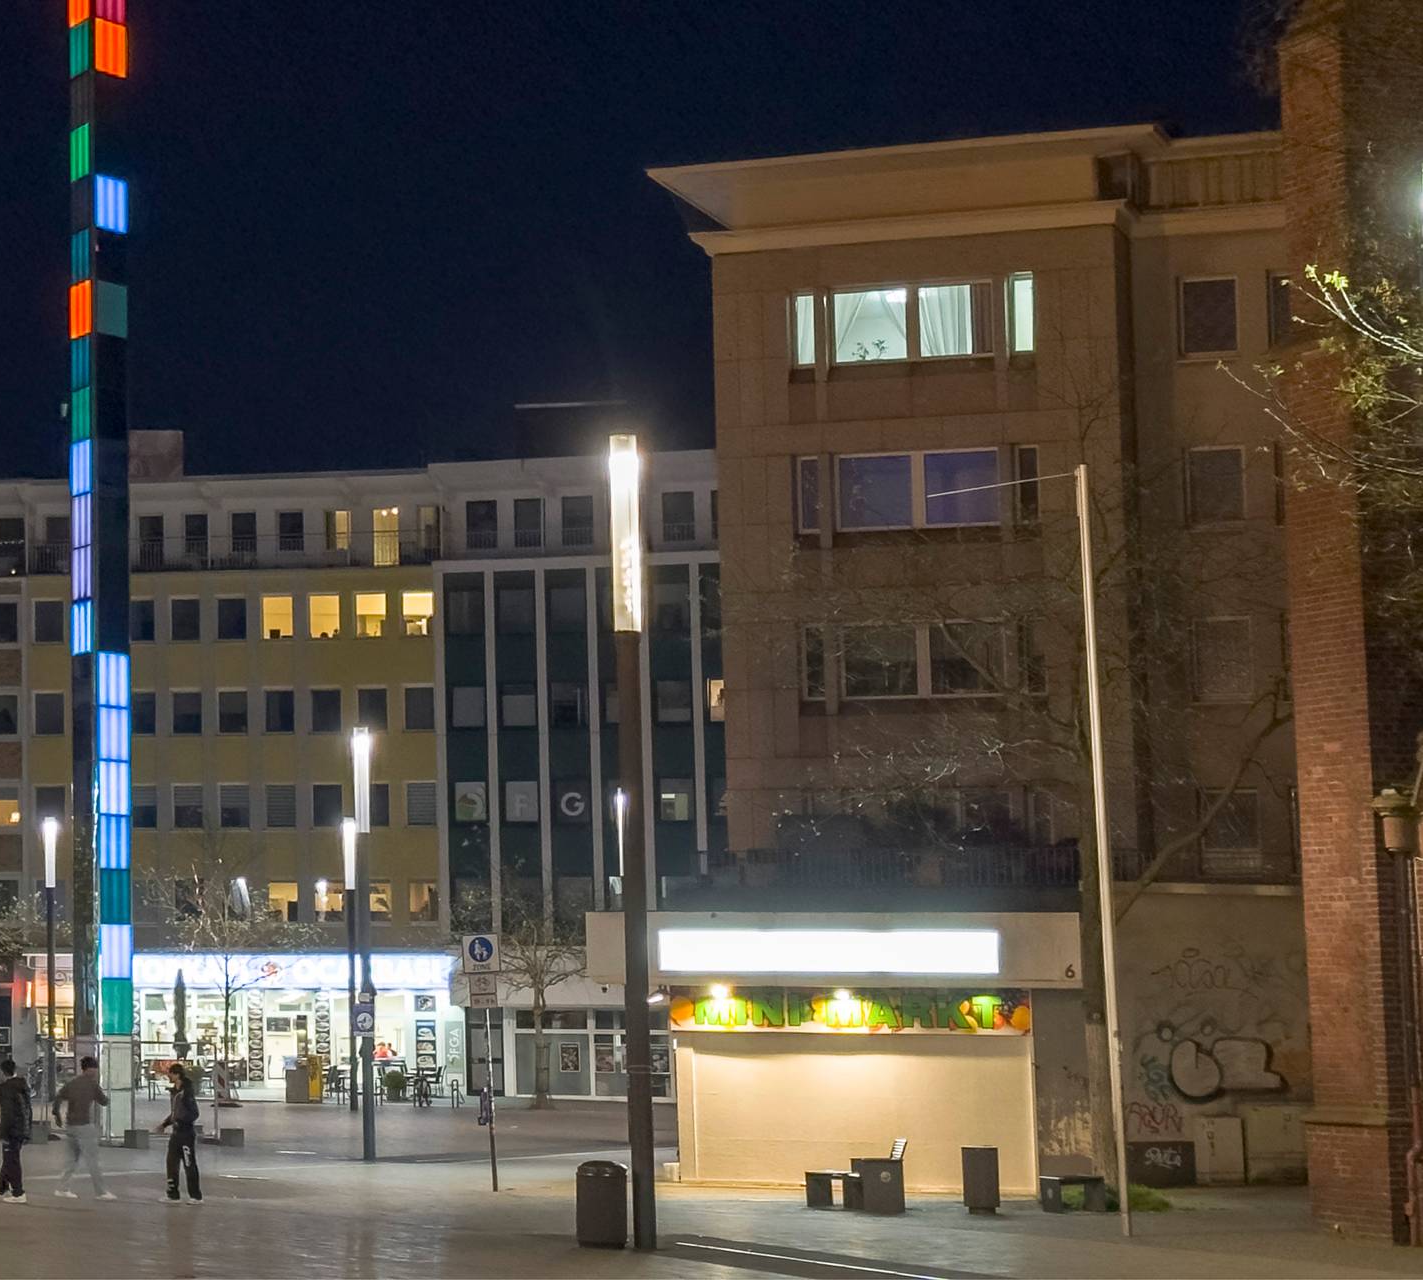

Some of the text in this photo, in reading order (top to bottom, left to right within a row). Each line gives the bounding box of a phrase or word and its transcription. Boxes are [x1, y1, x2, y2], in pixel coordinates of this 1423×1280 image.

[560, 792, 585, 816] G
[1064, 964, 1076, 980] 6
[694, 994, 1003, 1031] MINI MARKT
